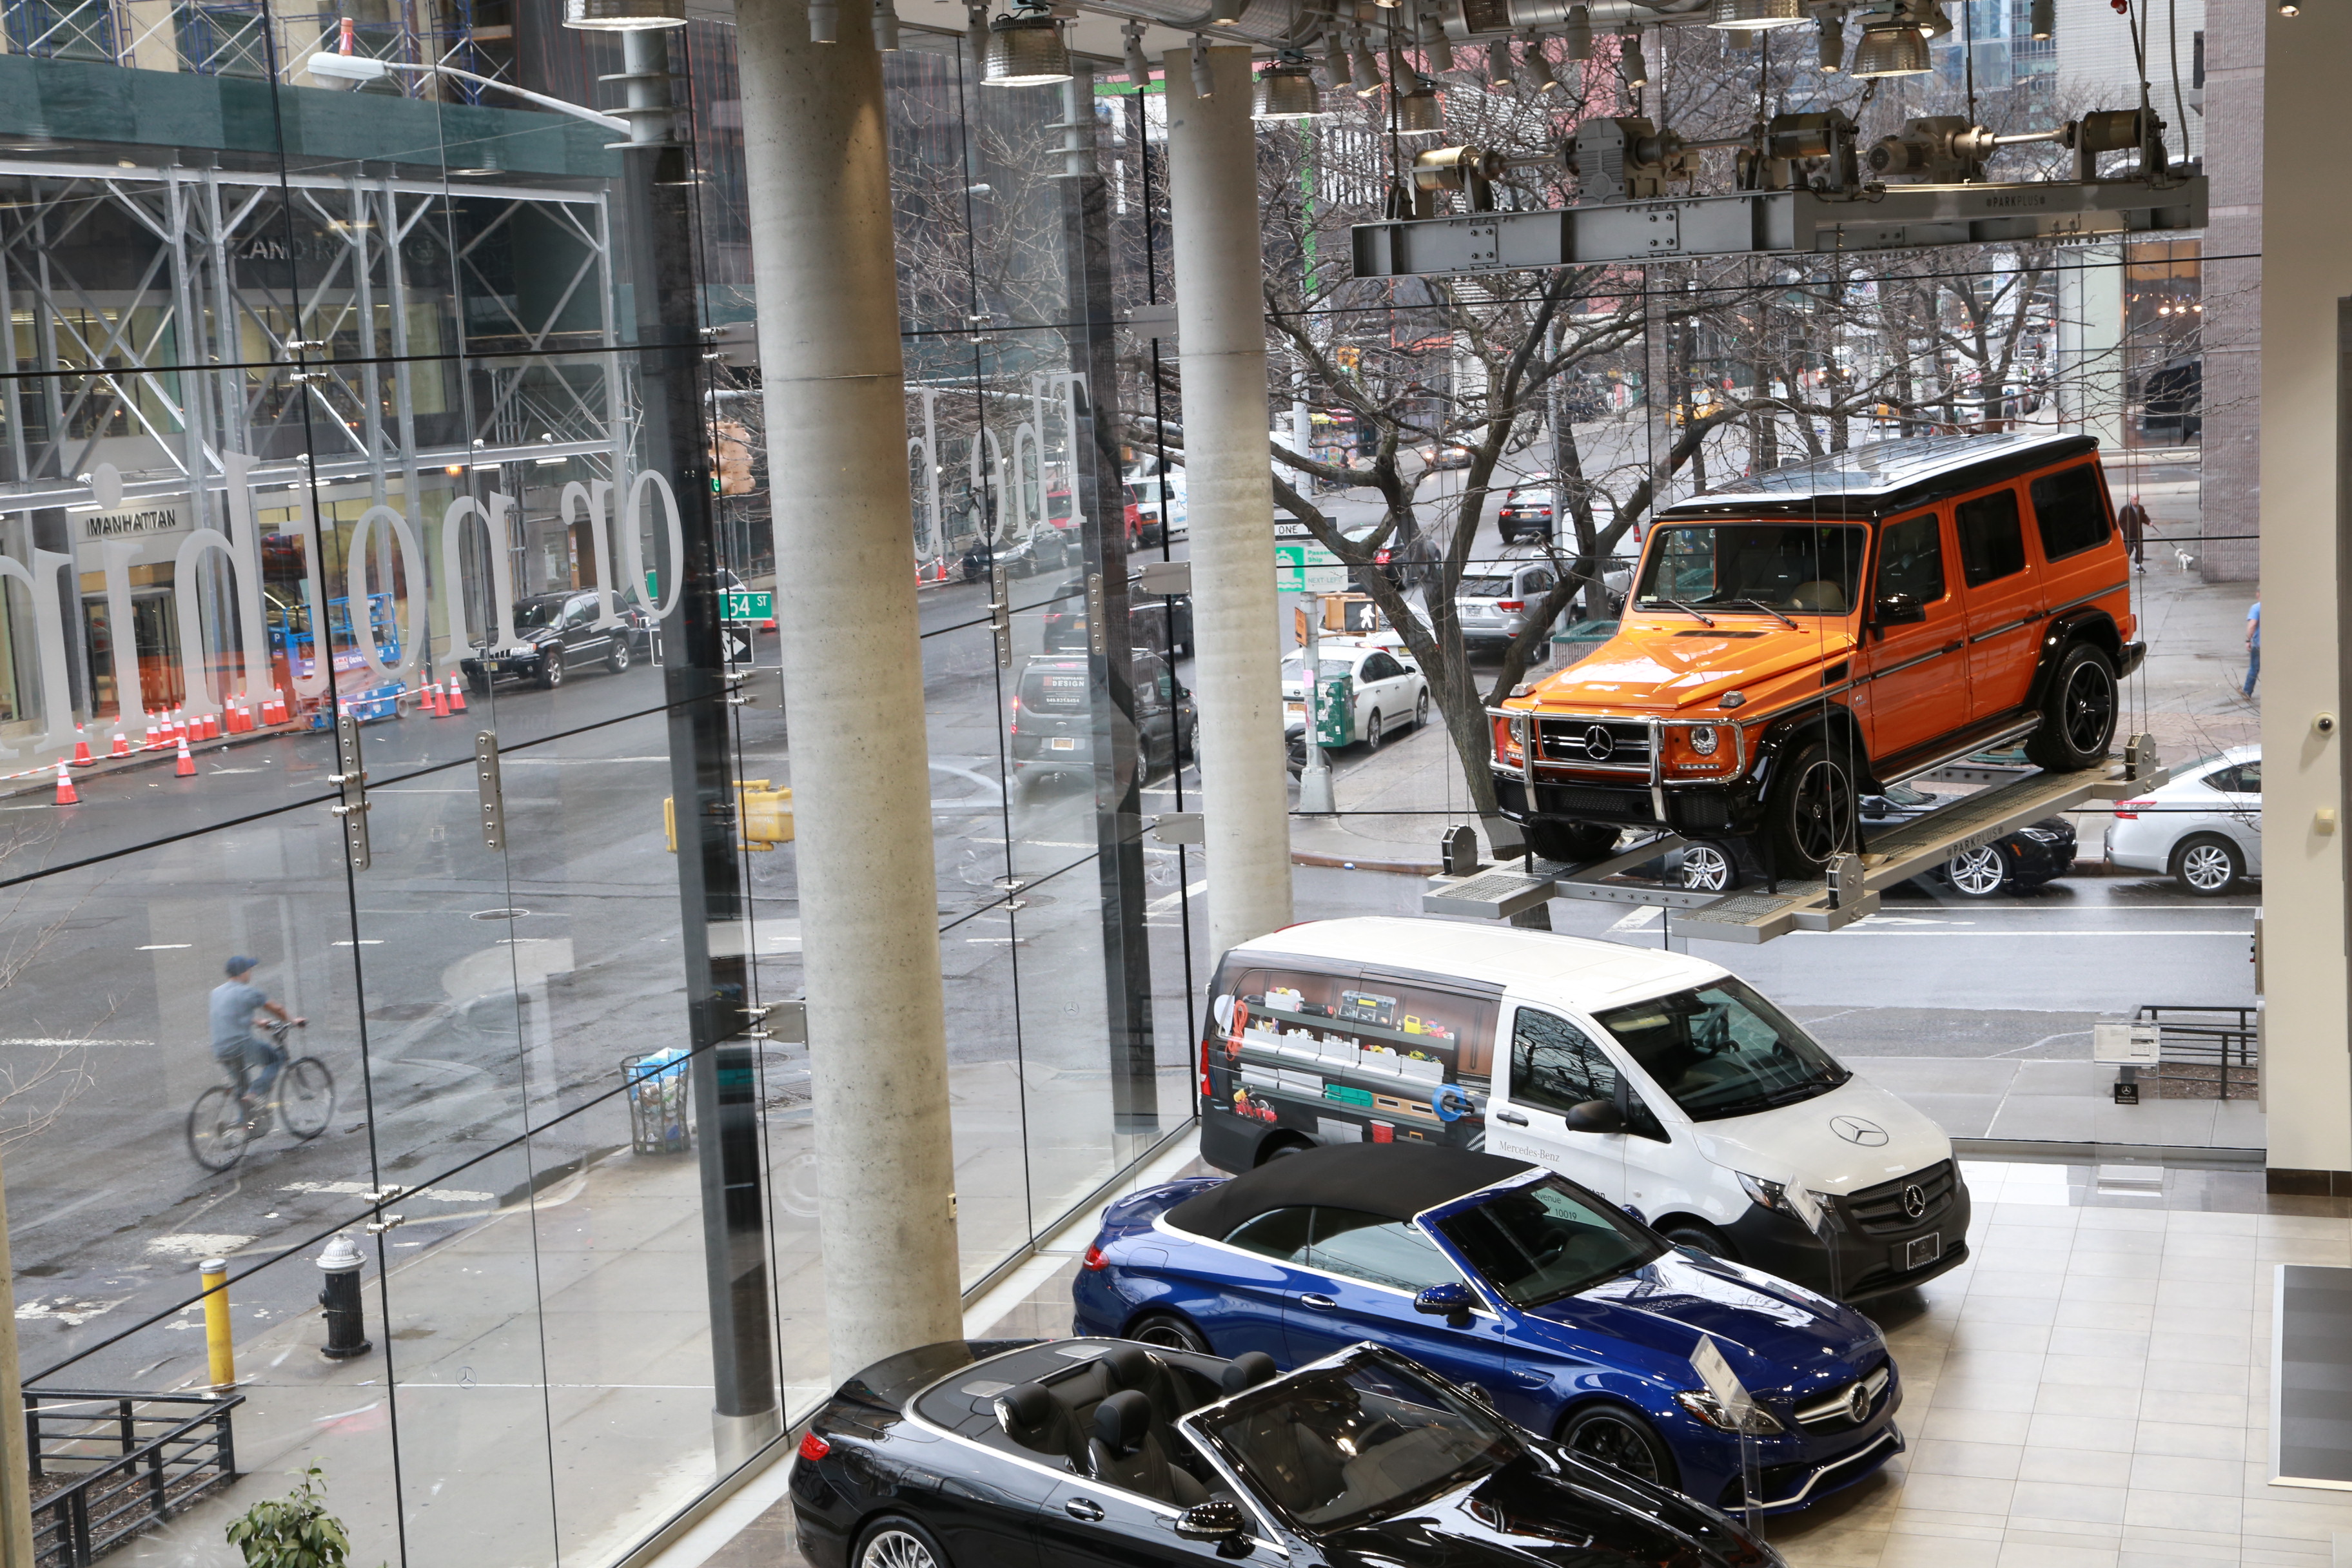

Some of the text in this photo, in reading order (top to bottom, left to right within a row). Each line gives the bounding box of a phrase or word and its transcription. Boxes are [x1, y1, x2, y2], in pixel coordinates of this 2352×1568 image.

[1993, 195, 2038, 207] PARKPLUS
[86, 509, 175, 536] MANHATTAN
[1279, 525, 1298, 534] ONE
[729, 595, 767, 616] 54 ST
[274, 633, 280, 642] P
[1954, 828, 1997, 854] PARKPLUS
[1499, 1141, 1560, 1162] Mercedes-Benz
[1534, 1191, 1562, 1204] Avenue
[1555, 1208, 1577, 1220] 10019
